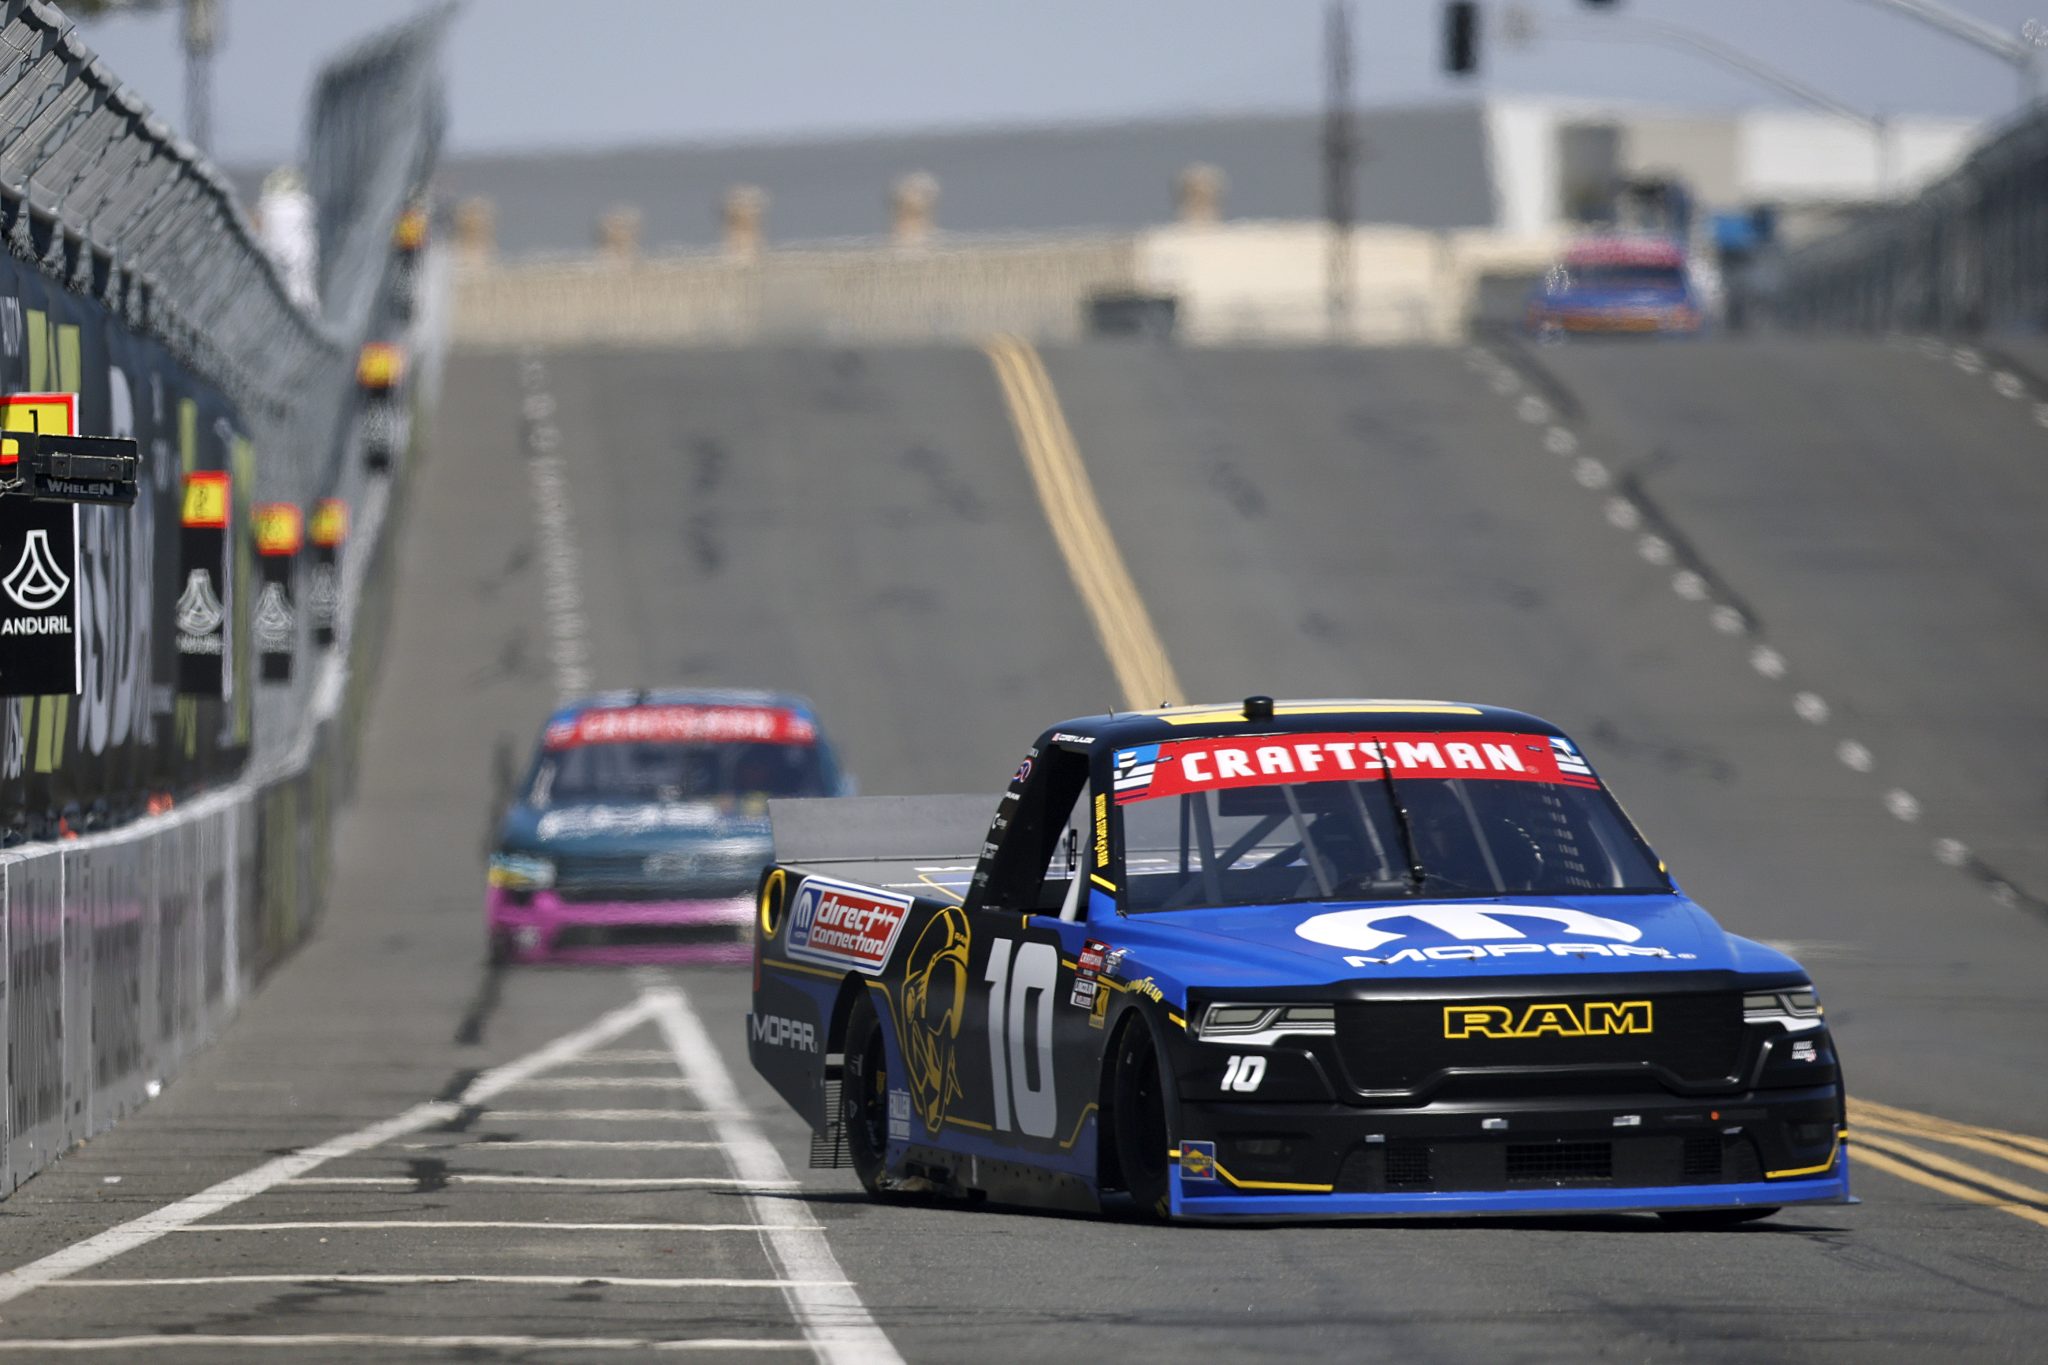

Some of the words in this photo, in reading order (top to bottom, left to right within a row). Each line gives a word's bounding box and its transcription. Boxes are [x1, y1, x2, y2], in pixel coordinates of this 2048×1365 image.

[47, 479, 114, 495] WHELEN
[1, 615, 72, 635] ANDURIL
[1181, 742, 1526, 782] CRAFTSMAN
[816, 895, 882, 932] direct
[811, 926, 884, 956] connection
[1343, 942, 1676, 968] MOPAR
[752, 1012, 816, 1053] MOPAR
[984, 937, 1058, 1138] 10
[1444, 1001, 1652, 1039] RAM
[1220, 1054, 1267, 1092] 10
